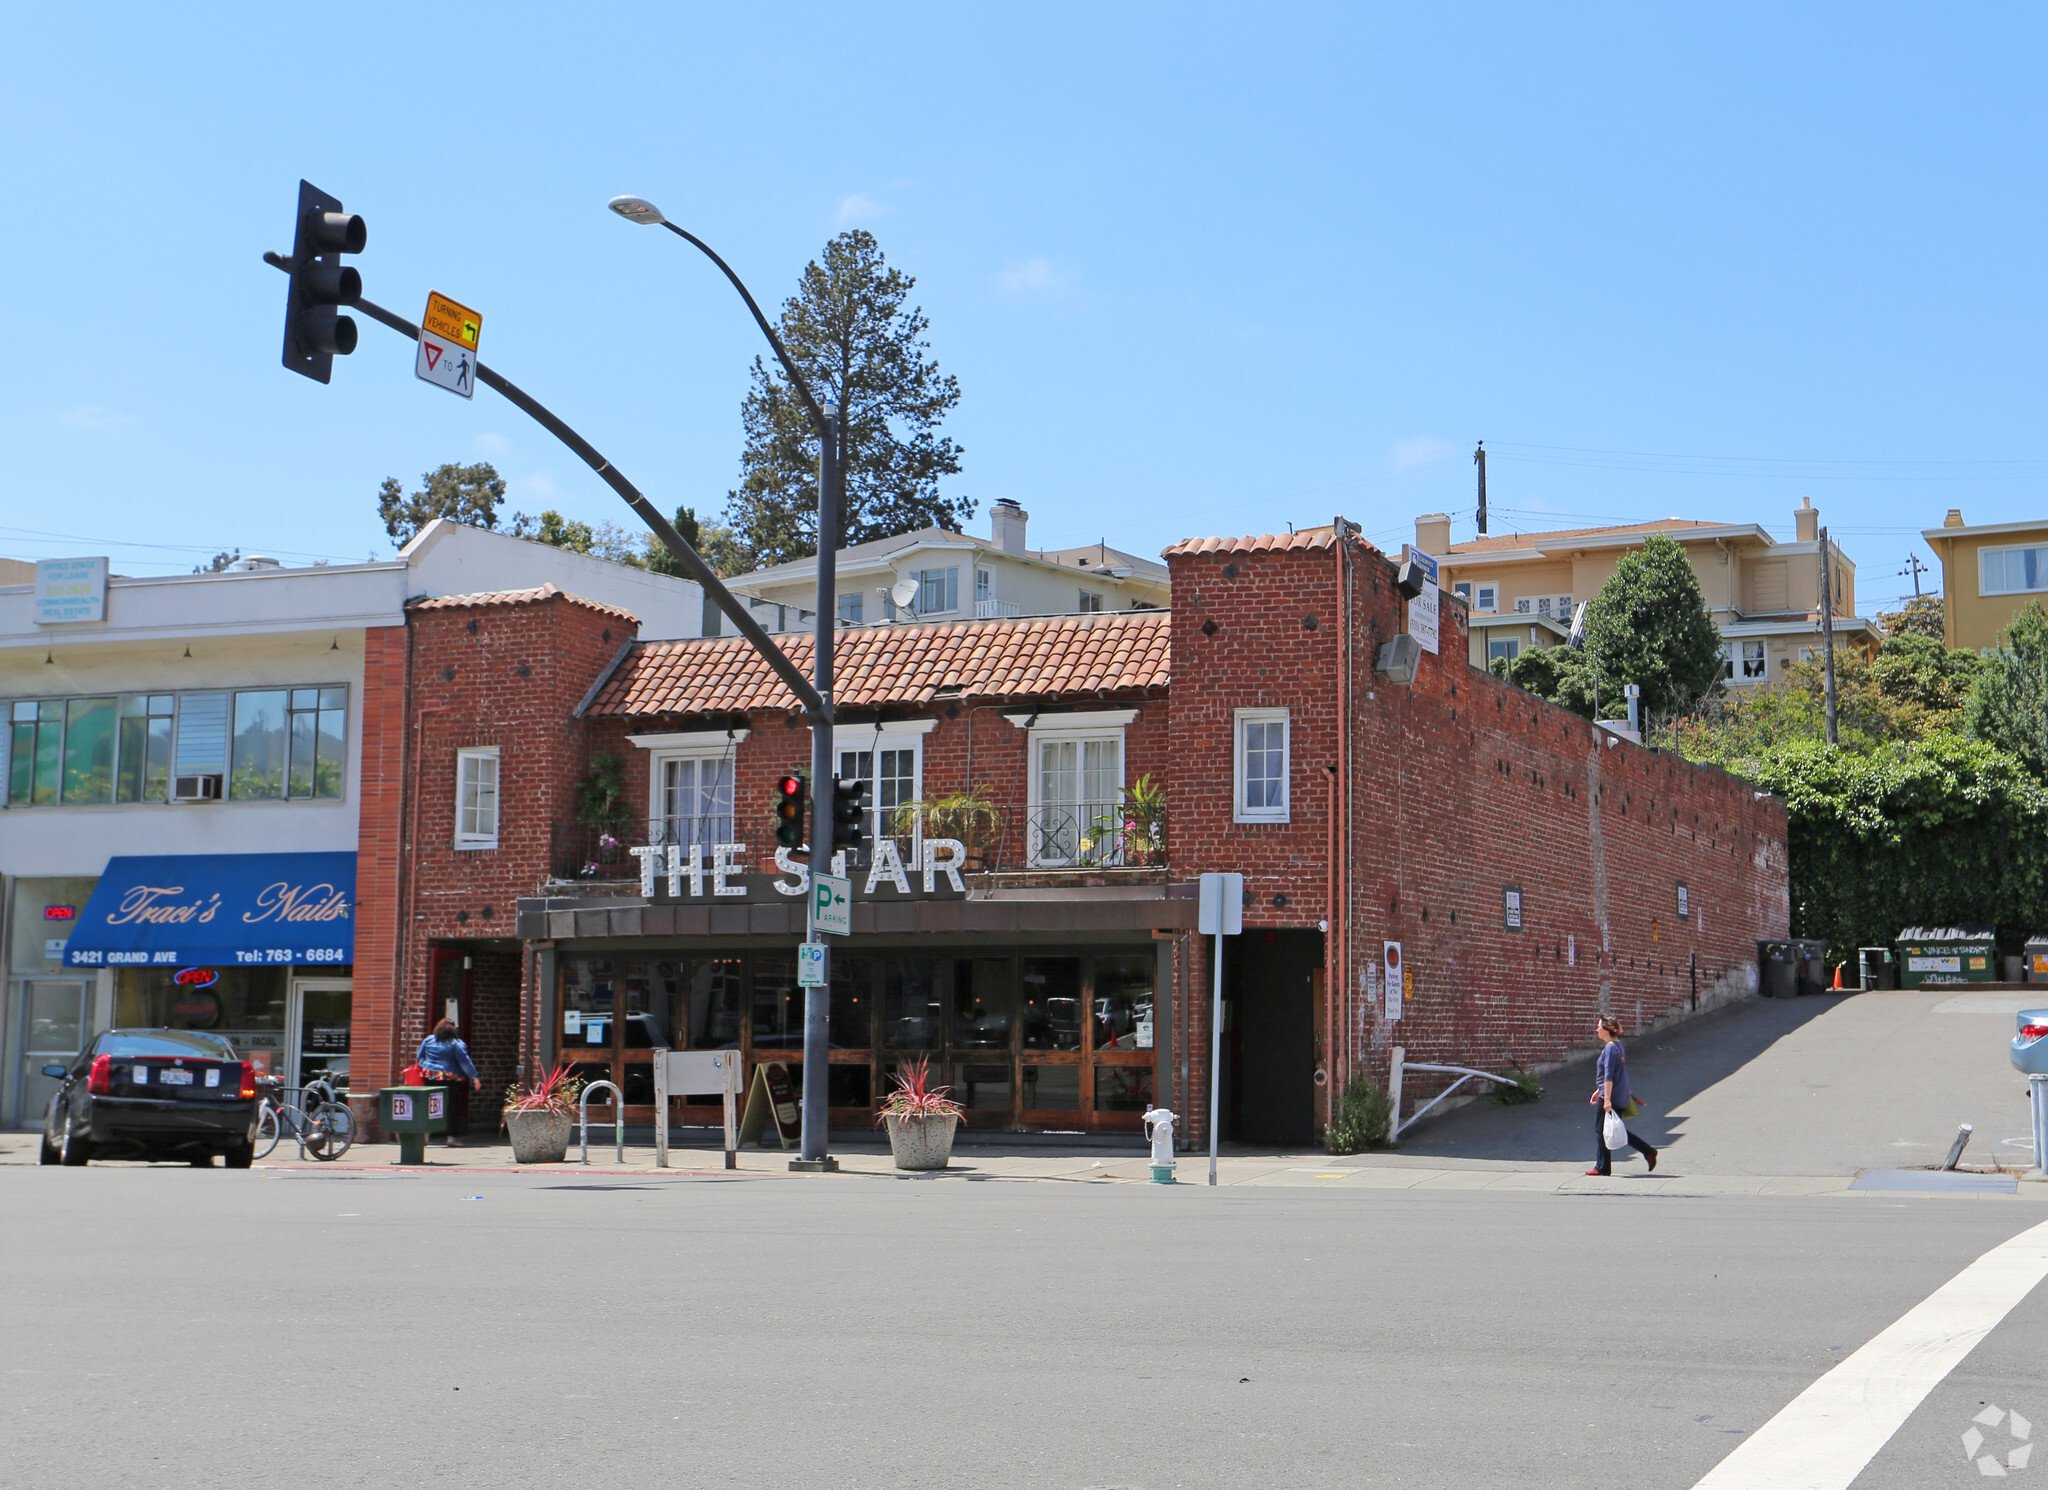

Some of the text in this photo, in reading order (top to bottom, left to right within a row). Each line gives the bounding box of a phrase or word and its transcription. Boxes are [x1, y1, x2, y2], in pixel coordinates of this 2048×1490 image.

[433, 300, 462, 322] TURNING
[427, 314, 461, 339] VEHICLES
[443, 359, 453, 372] TO
[1422, 599, 1437, 615] SALE
[630, 843, 747, 897] THE
[106, 882, 346, 925] Traci's Nails
[45, 907, 73, 918] OPEN
[72, 950, 177, 963] 3421 GRAND AVE
[236, 950, 262, 962] Tel:
[265, 949, 293, 962] 763
[305, 949, 344, 961] 6684
[177, 970, 213, 984] OPEN
[252, 1036, 277, 1047] FACIAL
